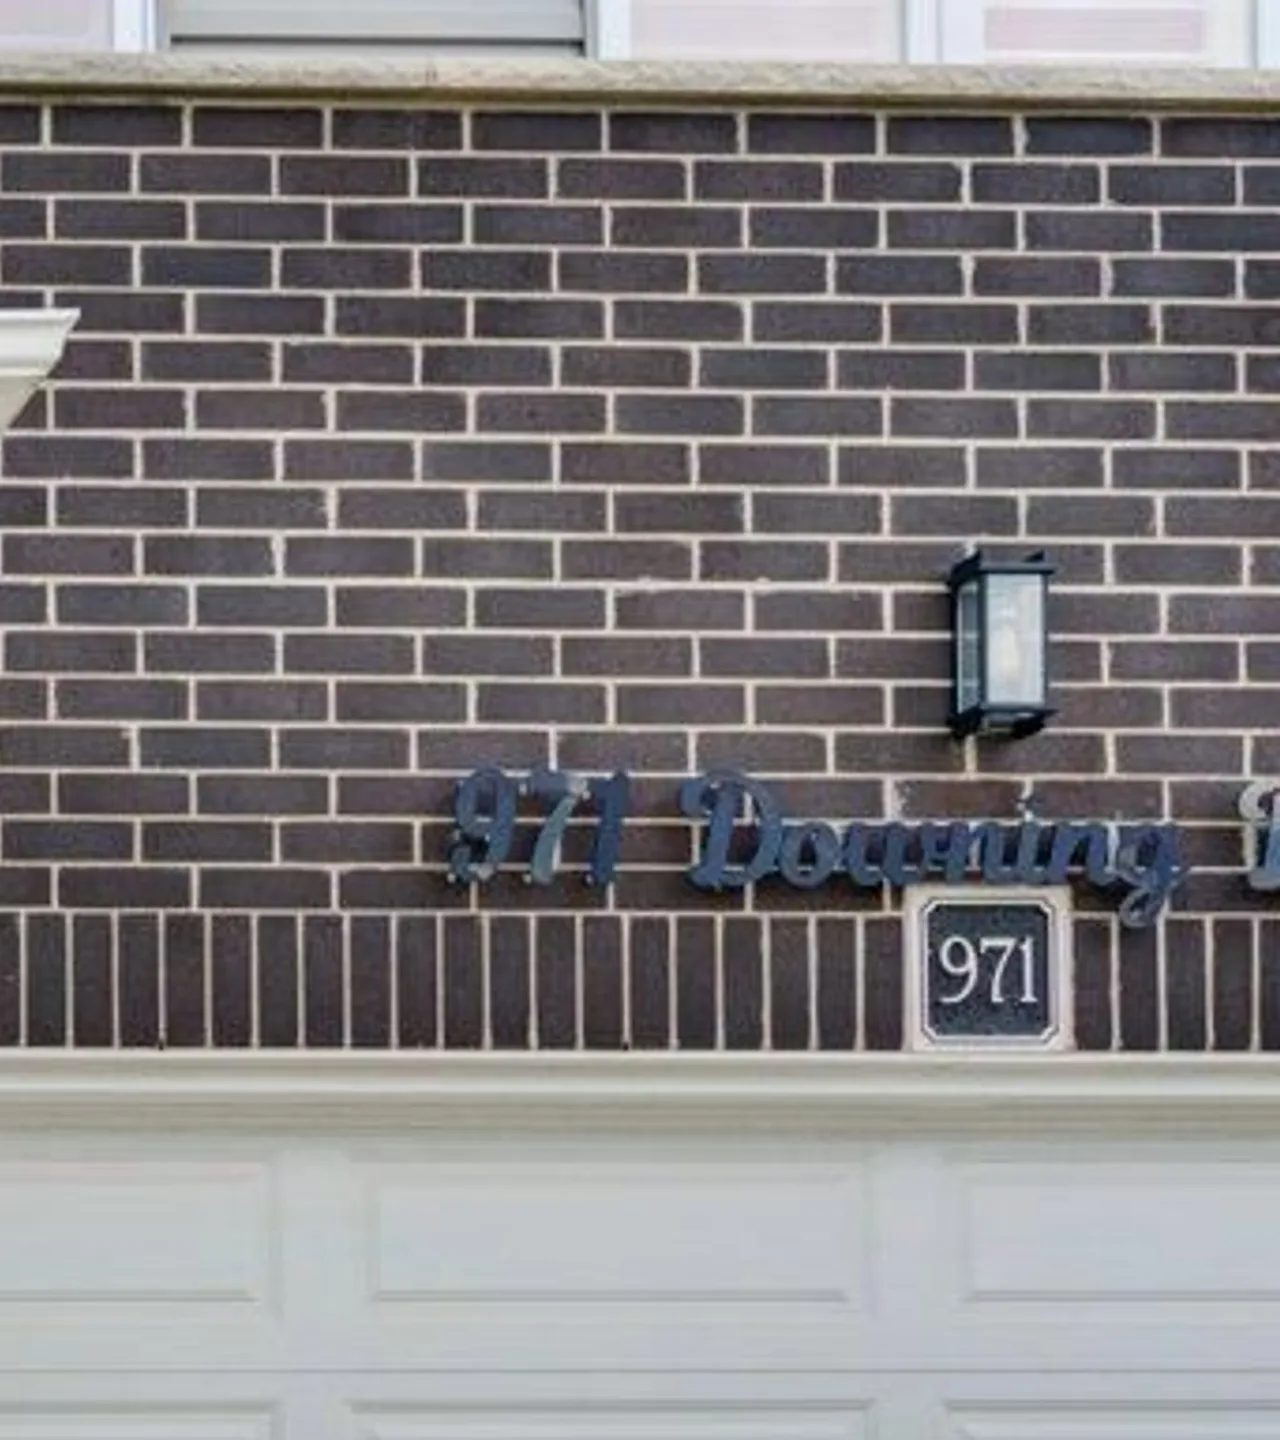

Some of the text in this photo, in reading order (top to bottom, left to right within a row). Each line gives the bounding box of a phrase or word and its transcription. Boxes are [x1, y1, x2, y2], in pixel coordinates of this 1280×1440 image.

[447, 765, 631, 886] 971
[680, 769, 1191, 927] Downing
[938, 936, 1039, 1006] 971
